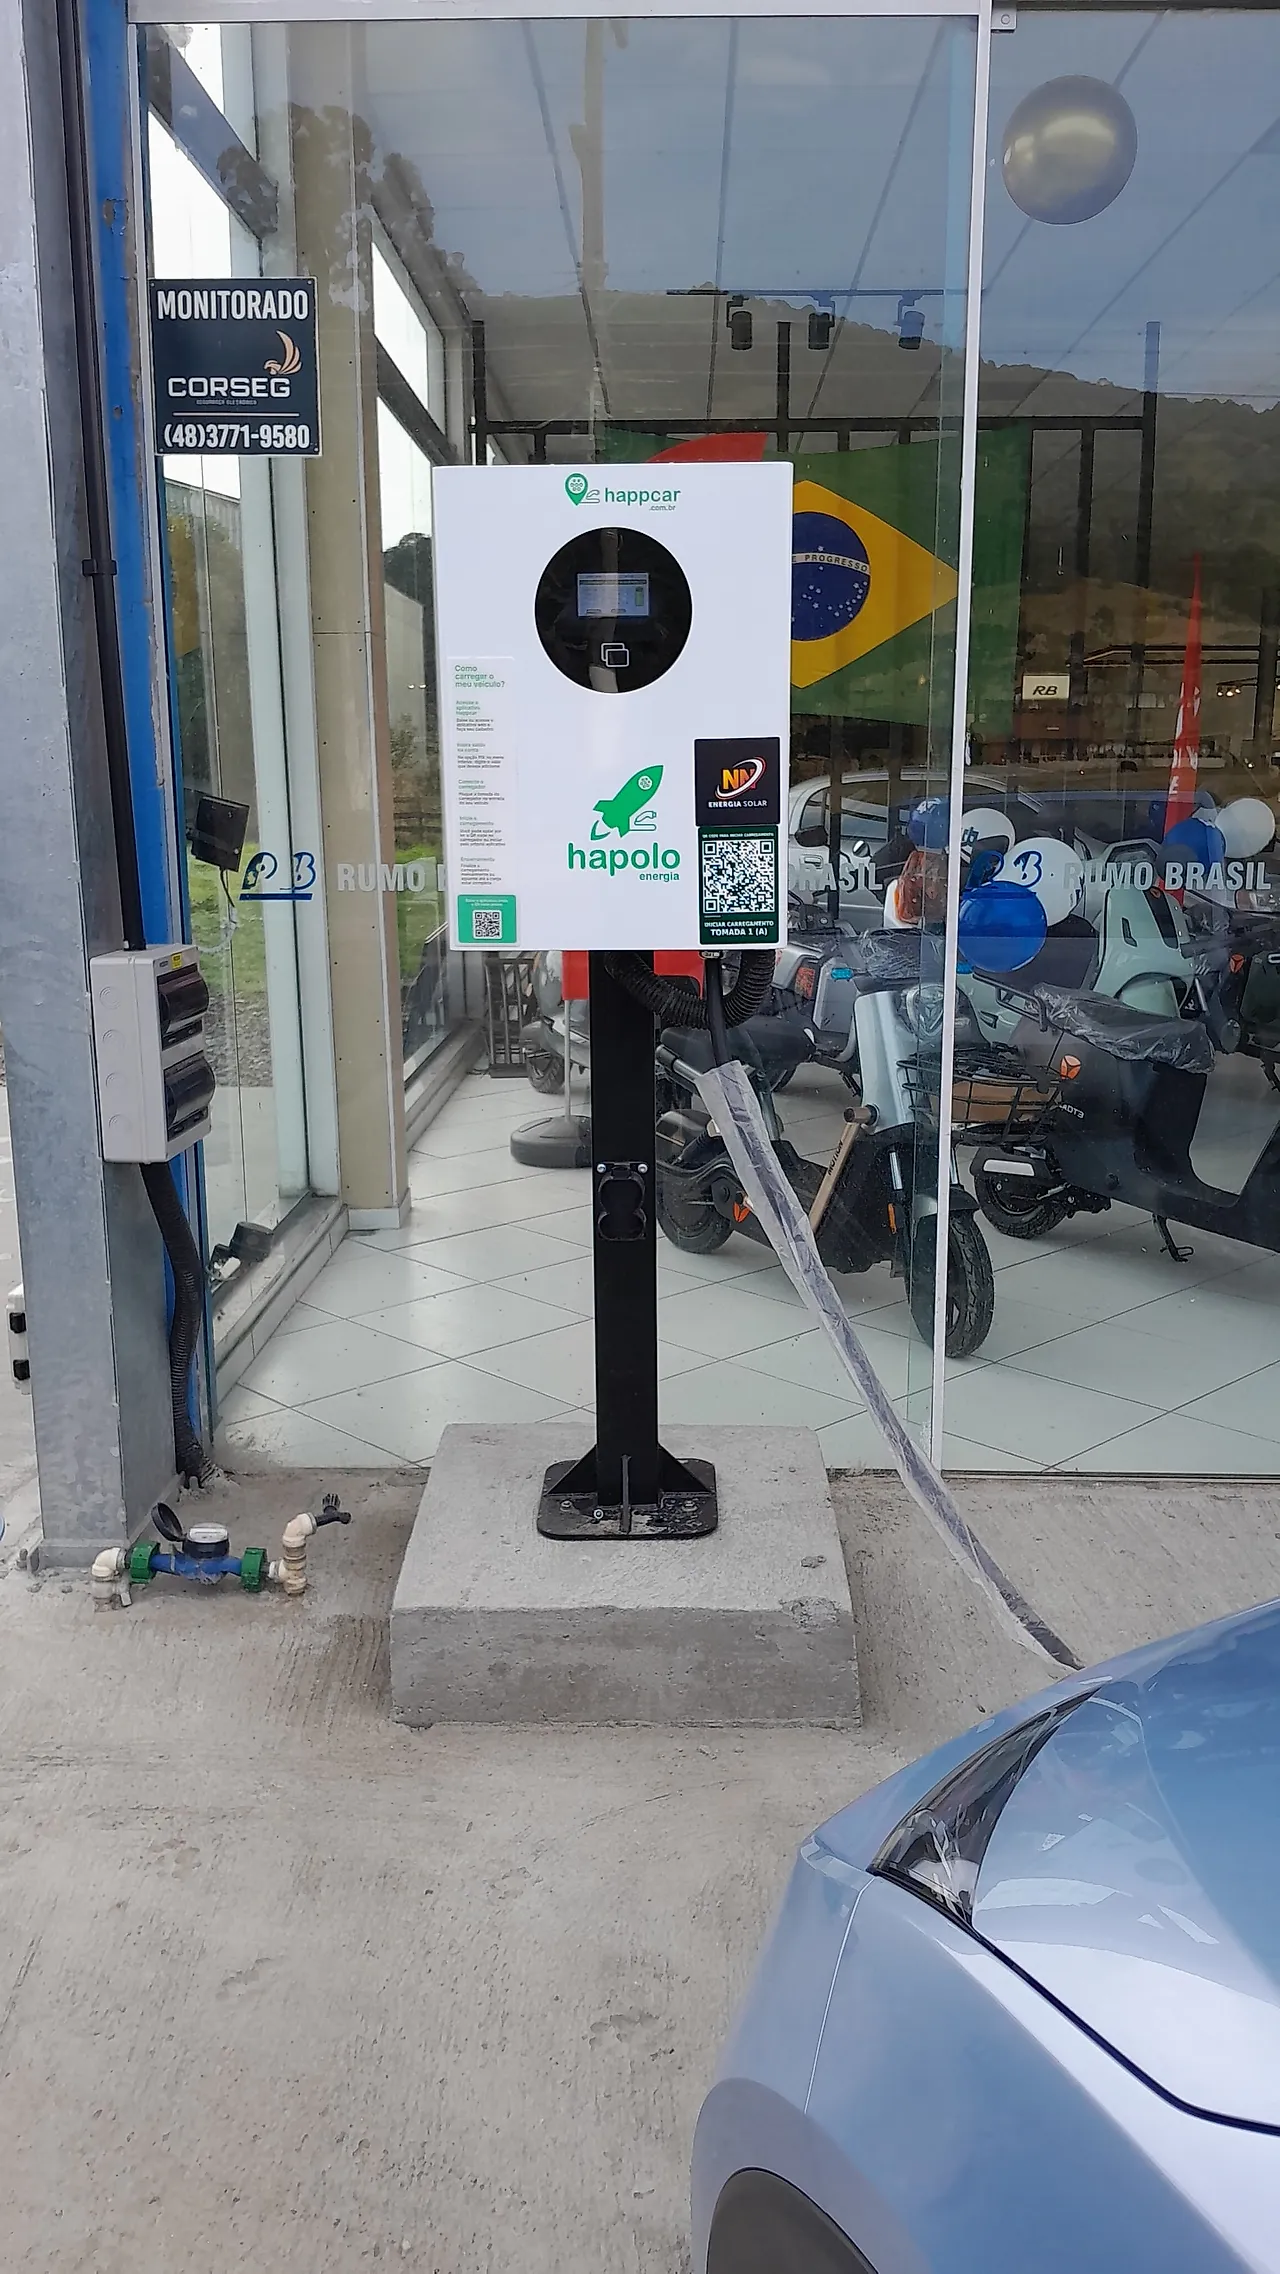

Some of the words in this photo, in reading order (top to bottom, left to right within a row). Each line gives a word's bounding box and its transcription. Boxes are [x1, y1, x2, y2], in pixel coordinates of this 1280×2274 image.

[157, 290, 309, 320] MONITORADO
[168, 377, 290, 398] CORSEG
[164, 424, 310, 449] (48)3771-9580
[605, 487, 681, 506] happcar
[804, 554, 868, 572] PROGRESSO
[1033, 685, 1058, 696] RB
[568, 842, 681, 877] hapolo
[337, 863, 426, 892] RUMO
[639, 872, 680, 882] energia
[1063, 862, 1154, 891] RUMO
[1164, 862, 1272, 891] BRASIL
[710, 928, 746, 936] TOMADA
[748, 928, 754, 936] 1
[755, 927, 768, 937] (A)
